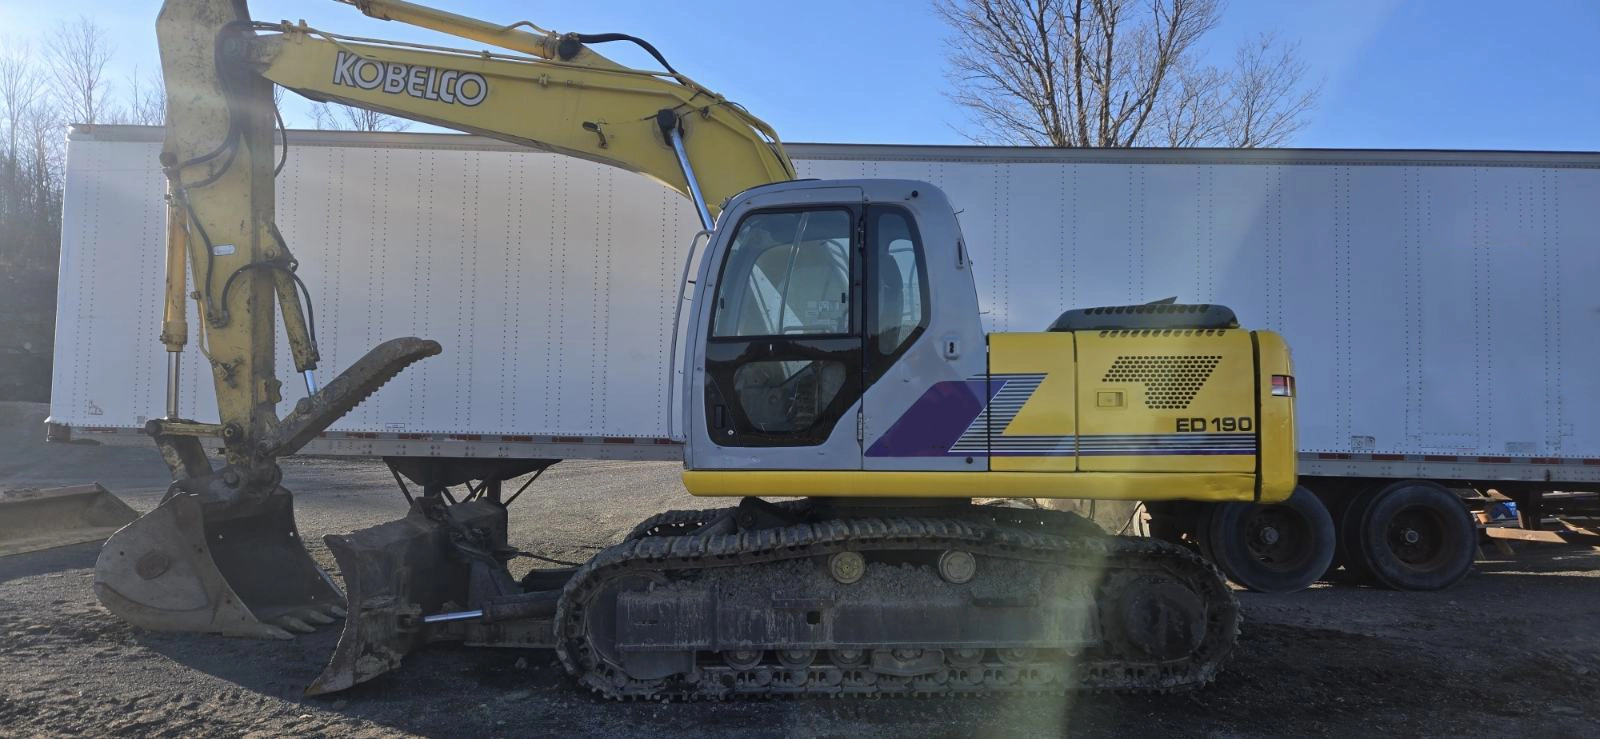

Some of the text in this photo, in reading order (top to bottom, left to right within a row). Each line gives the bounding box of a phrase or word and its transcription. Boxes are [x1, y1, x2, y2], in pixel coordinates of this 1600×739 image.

[333, 51, 488, 107] KOBELCO
[1176, 416, 1253, 432] ED 190
